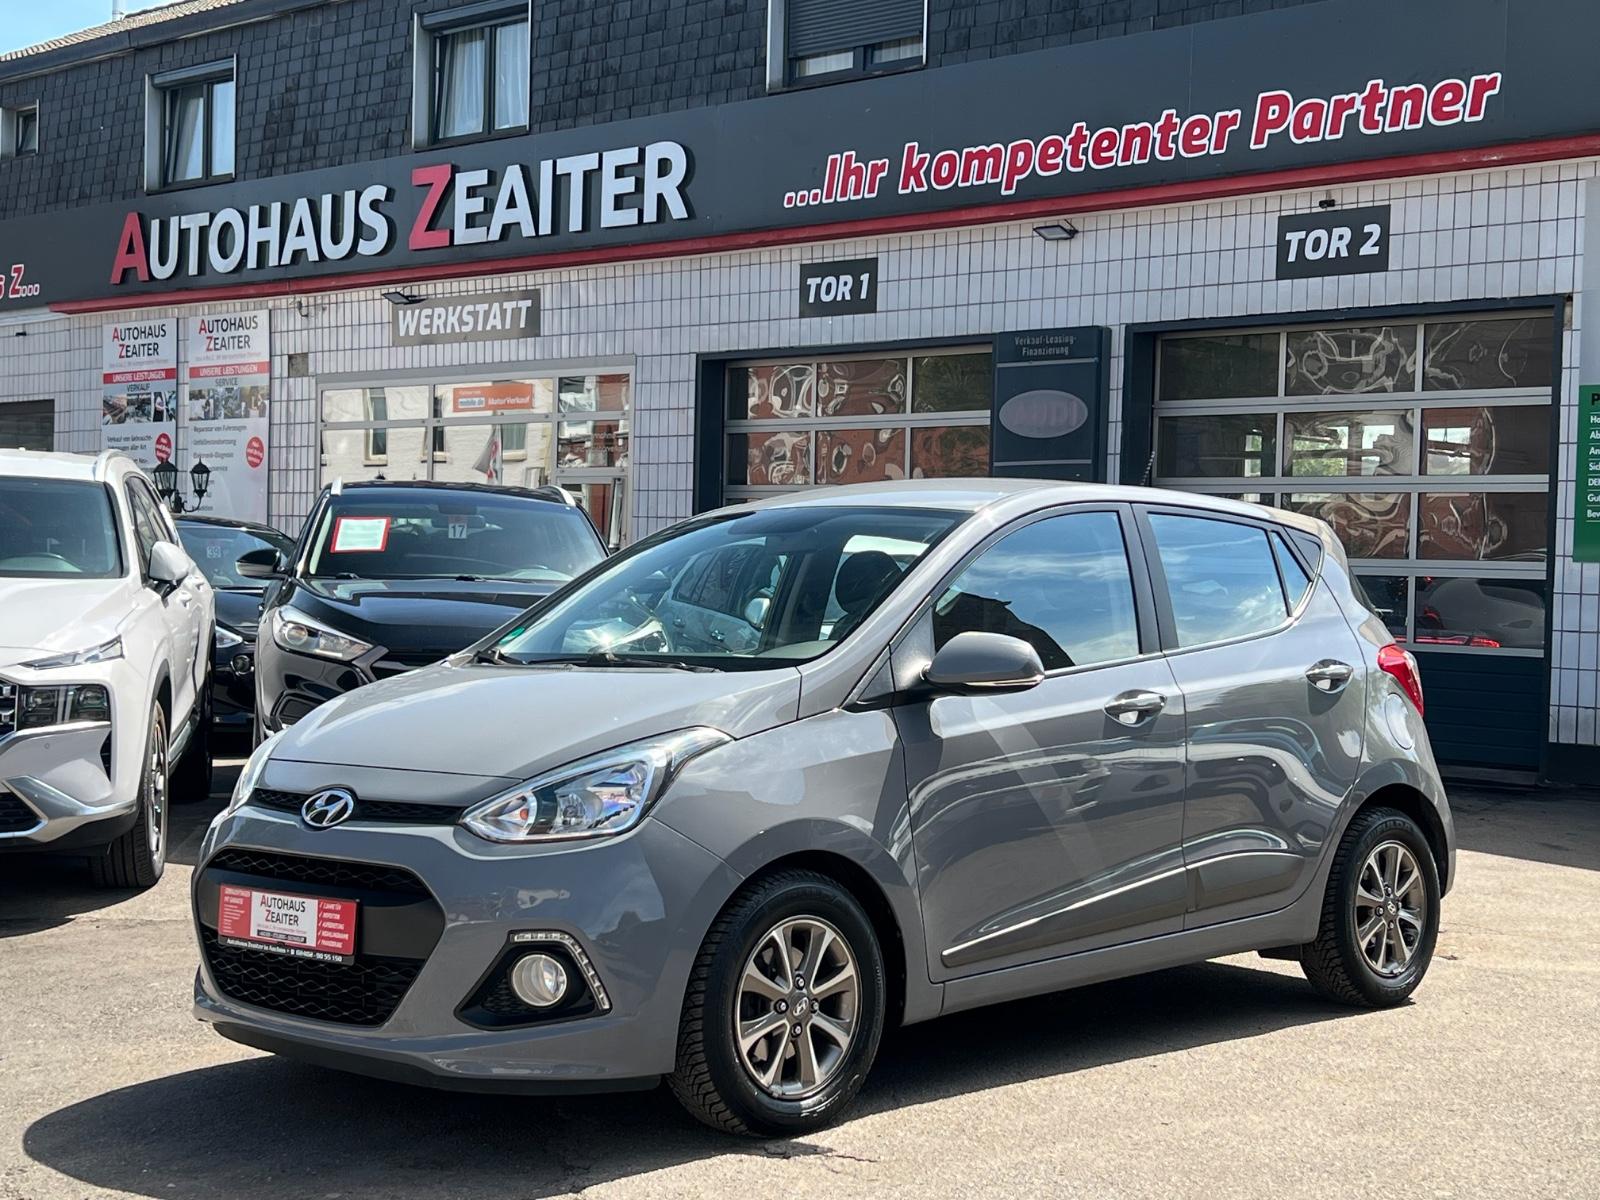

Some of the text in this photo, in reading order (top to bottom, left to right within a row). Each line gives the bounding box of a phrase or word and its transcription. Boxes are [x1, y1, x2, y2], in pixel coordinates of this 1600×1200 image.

[784, 72, 1502, 208] ...Ihr kompetenter Partner
[110, 140, 690, 284] AUTOHAUS ZEAITER
[1285, 223, 1381, 262] TOR 2
[806, 272, 870, 304] TOR 1
[198, 315, 259, 335] AUTOHAUS
[398, 299, 533, 337] WERKSTATT
[112, 323, 167, 342] AUTOHAUS
[118, 342, 160, 359] ZEAITER
[206, 334, 251, 352] ZEAITER
[1022, 346, 1069, 356] Finanzierung
[112, 370, 166, 382] UNSERE LEISTUNGEN
[200, 364, 258, 377] UNSERE LEISTUNGEN
[126, 384, 150, 393] VERKAUF
[215, 377, 239, 387] SERVICE
[451, 525, 465, 538] 17
[260, 894, 306, 913] AUTOHAUS
[265, 909, 299, 926] ZEAITER
